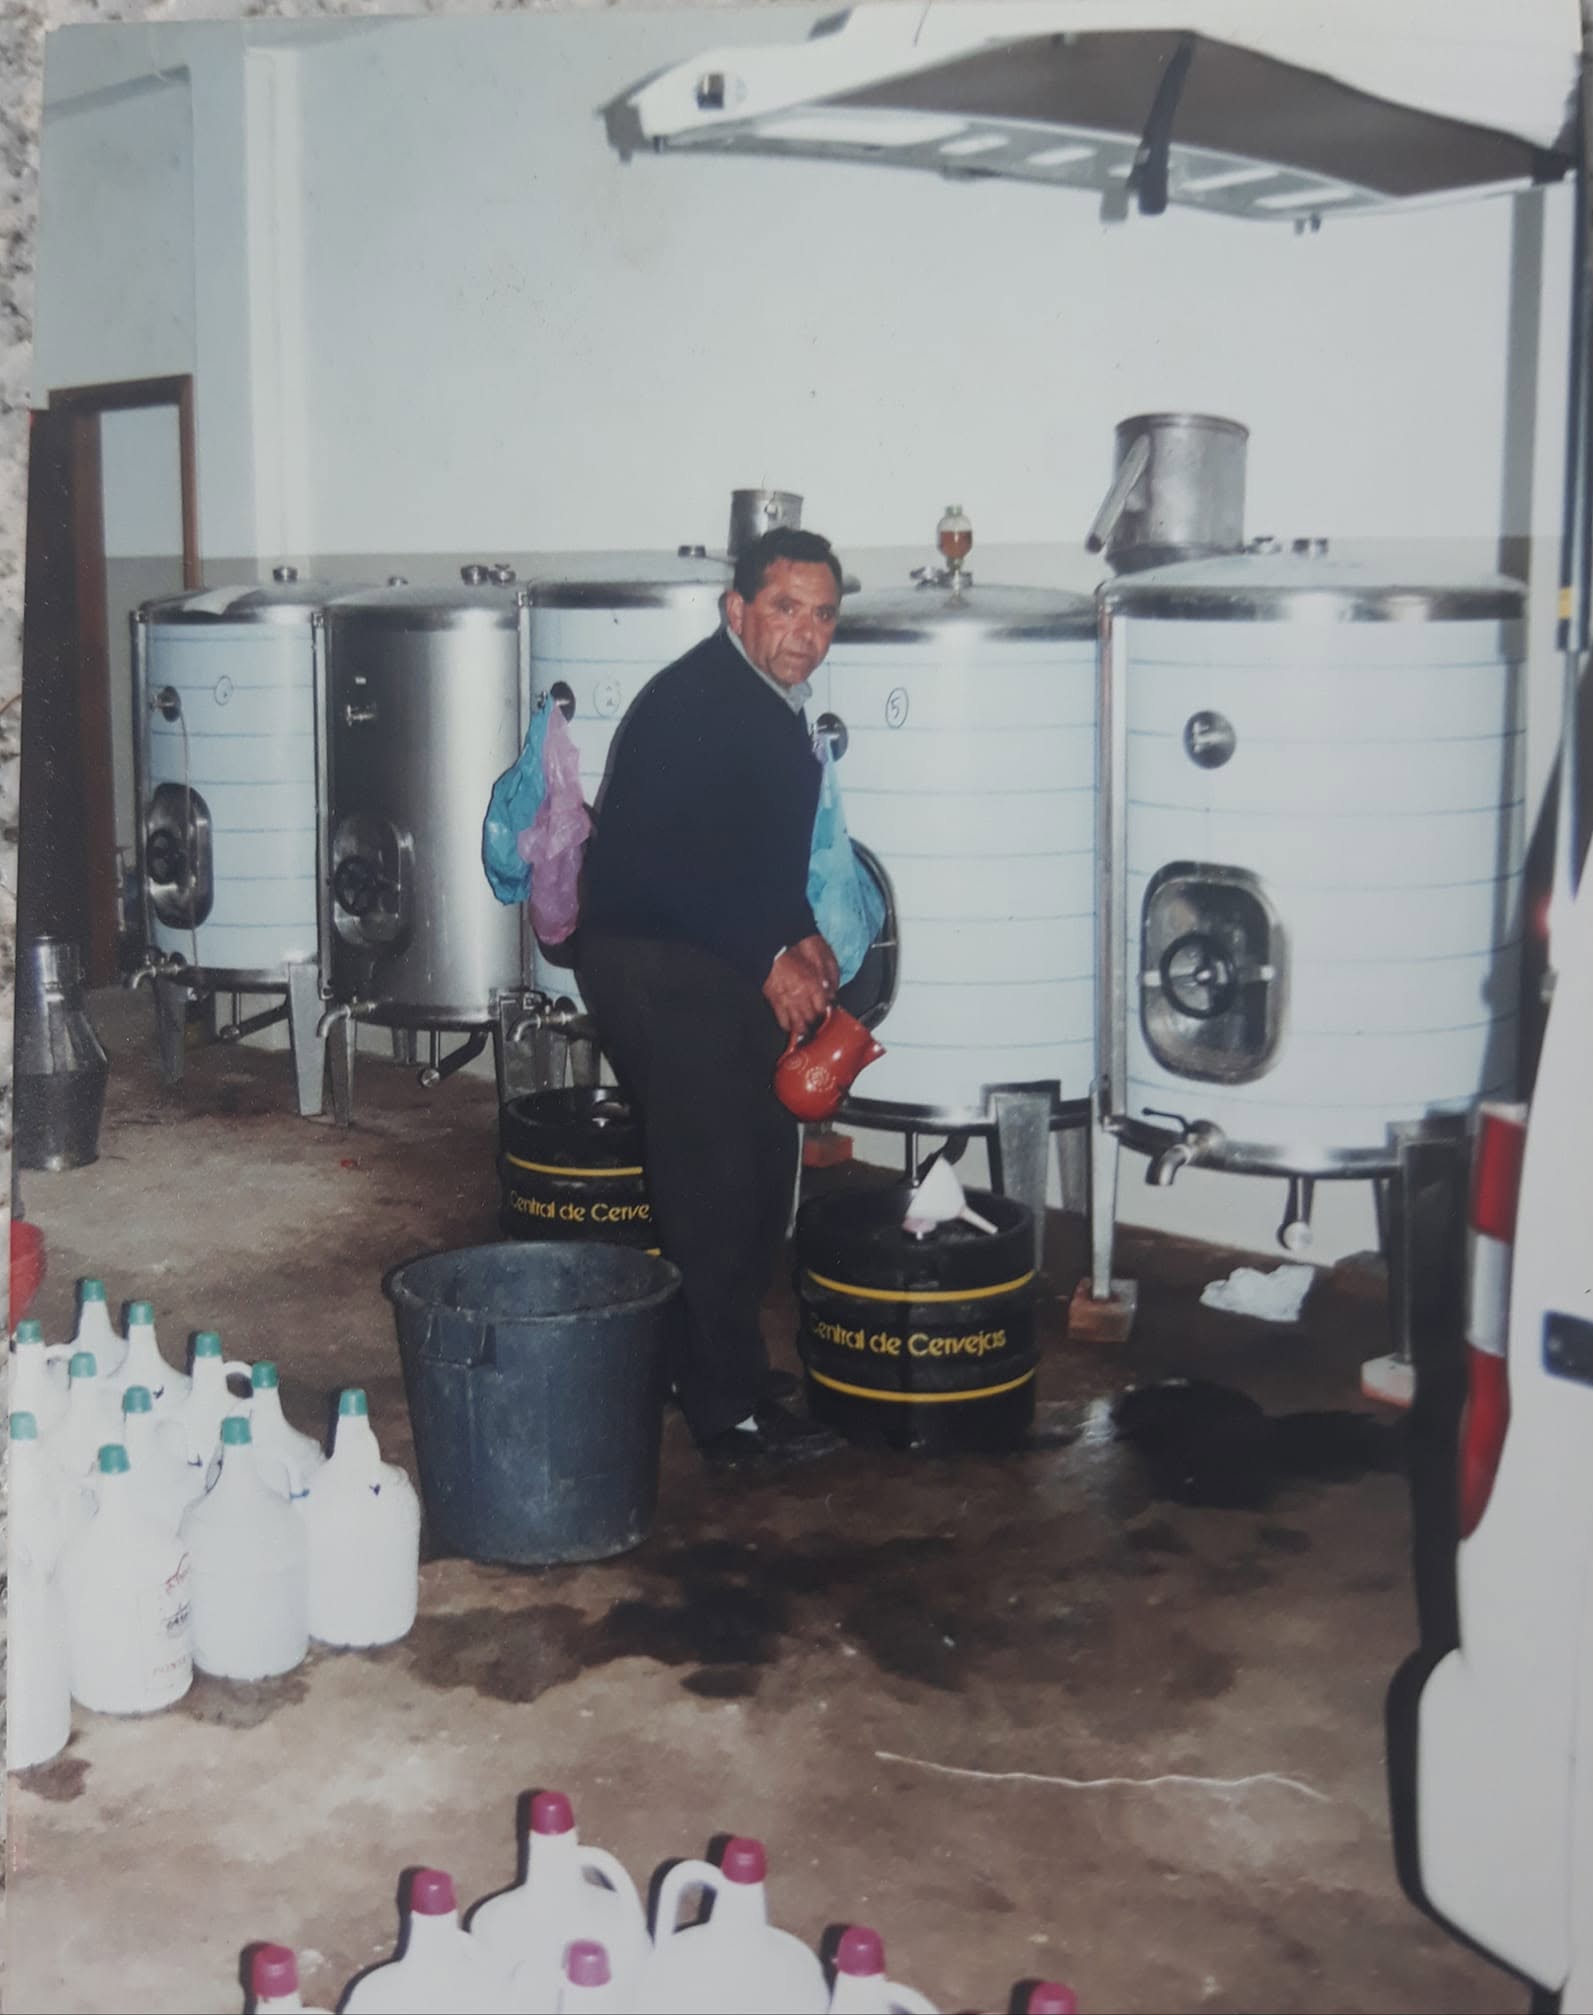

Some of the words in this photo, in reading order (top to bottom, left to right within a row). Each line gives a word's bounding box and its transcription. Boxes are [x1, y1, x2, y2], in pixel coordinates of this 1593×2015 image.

[511, 1190, 555, 1219] Central
[559, 1203, 586, 1222] de
[590, 1203, 653, 1222] Cerve
[869, 1332, 902, 1355] de
[908, 1329, 1006, 1357] Cervejas
